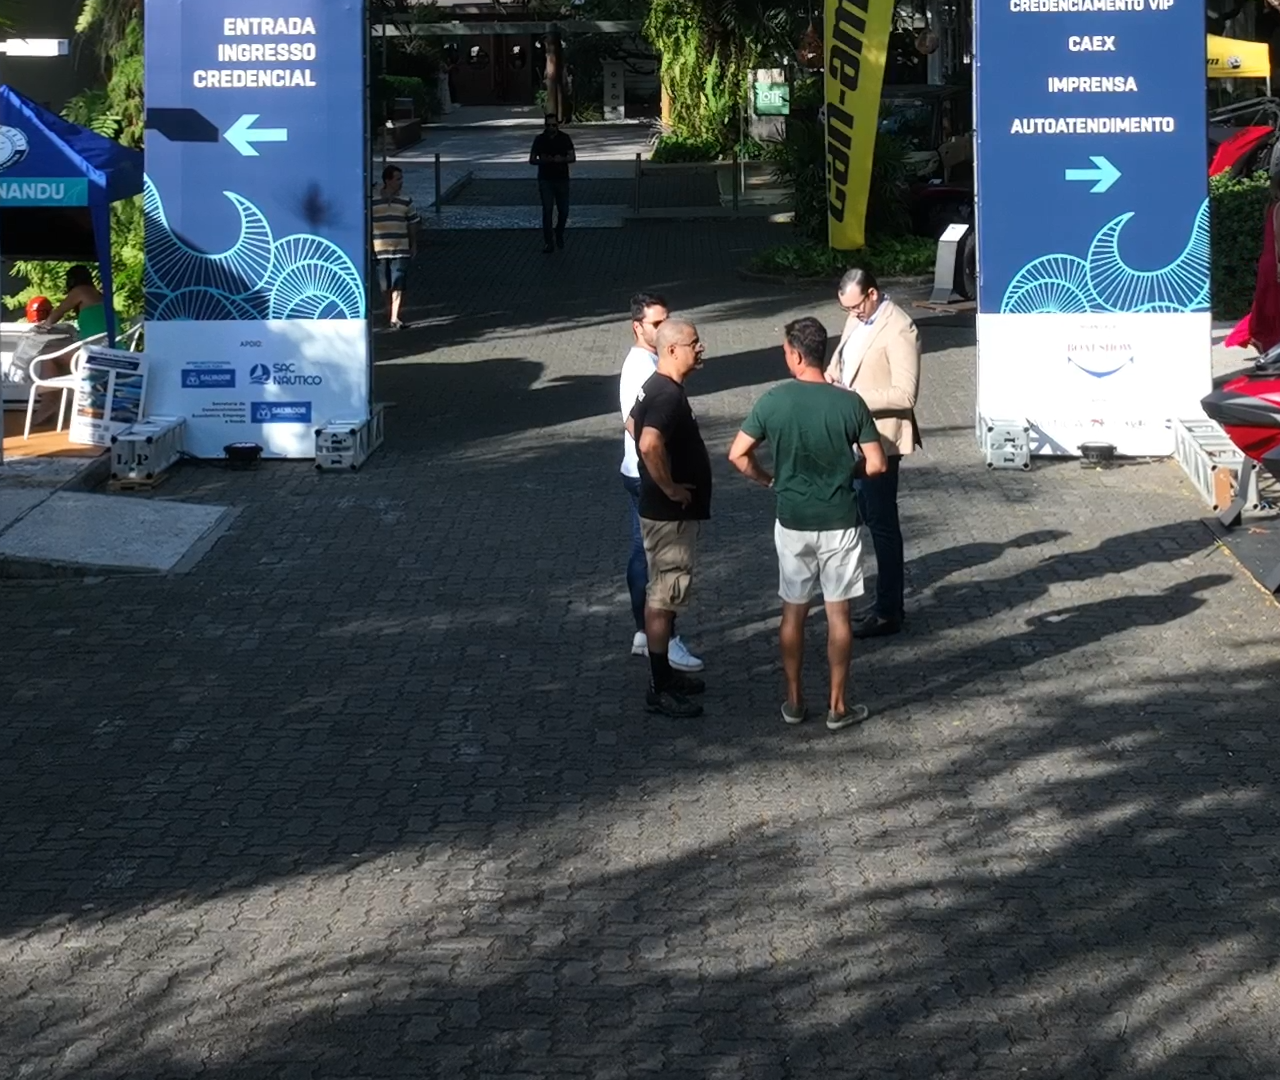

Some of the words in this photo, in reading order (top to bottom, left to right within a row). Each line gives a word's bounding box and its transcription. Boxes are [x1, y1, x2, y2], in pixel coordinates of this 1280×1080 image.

[223, 16, 316, 36] ENTRADA
[217, 42, 317, 62] INGRESSO
[1068, 35, 1116, 52] CAEX
[193, 68, 317, 88] CREDENCIAL
[1048, 76, 1138, 93] IMPRENSA
[1010, 116, 1175, 134] AUTOATENDIMENTO
[272, 363, 296, 374] SAC
[271, 406, 307, 414] SALVADOR
